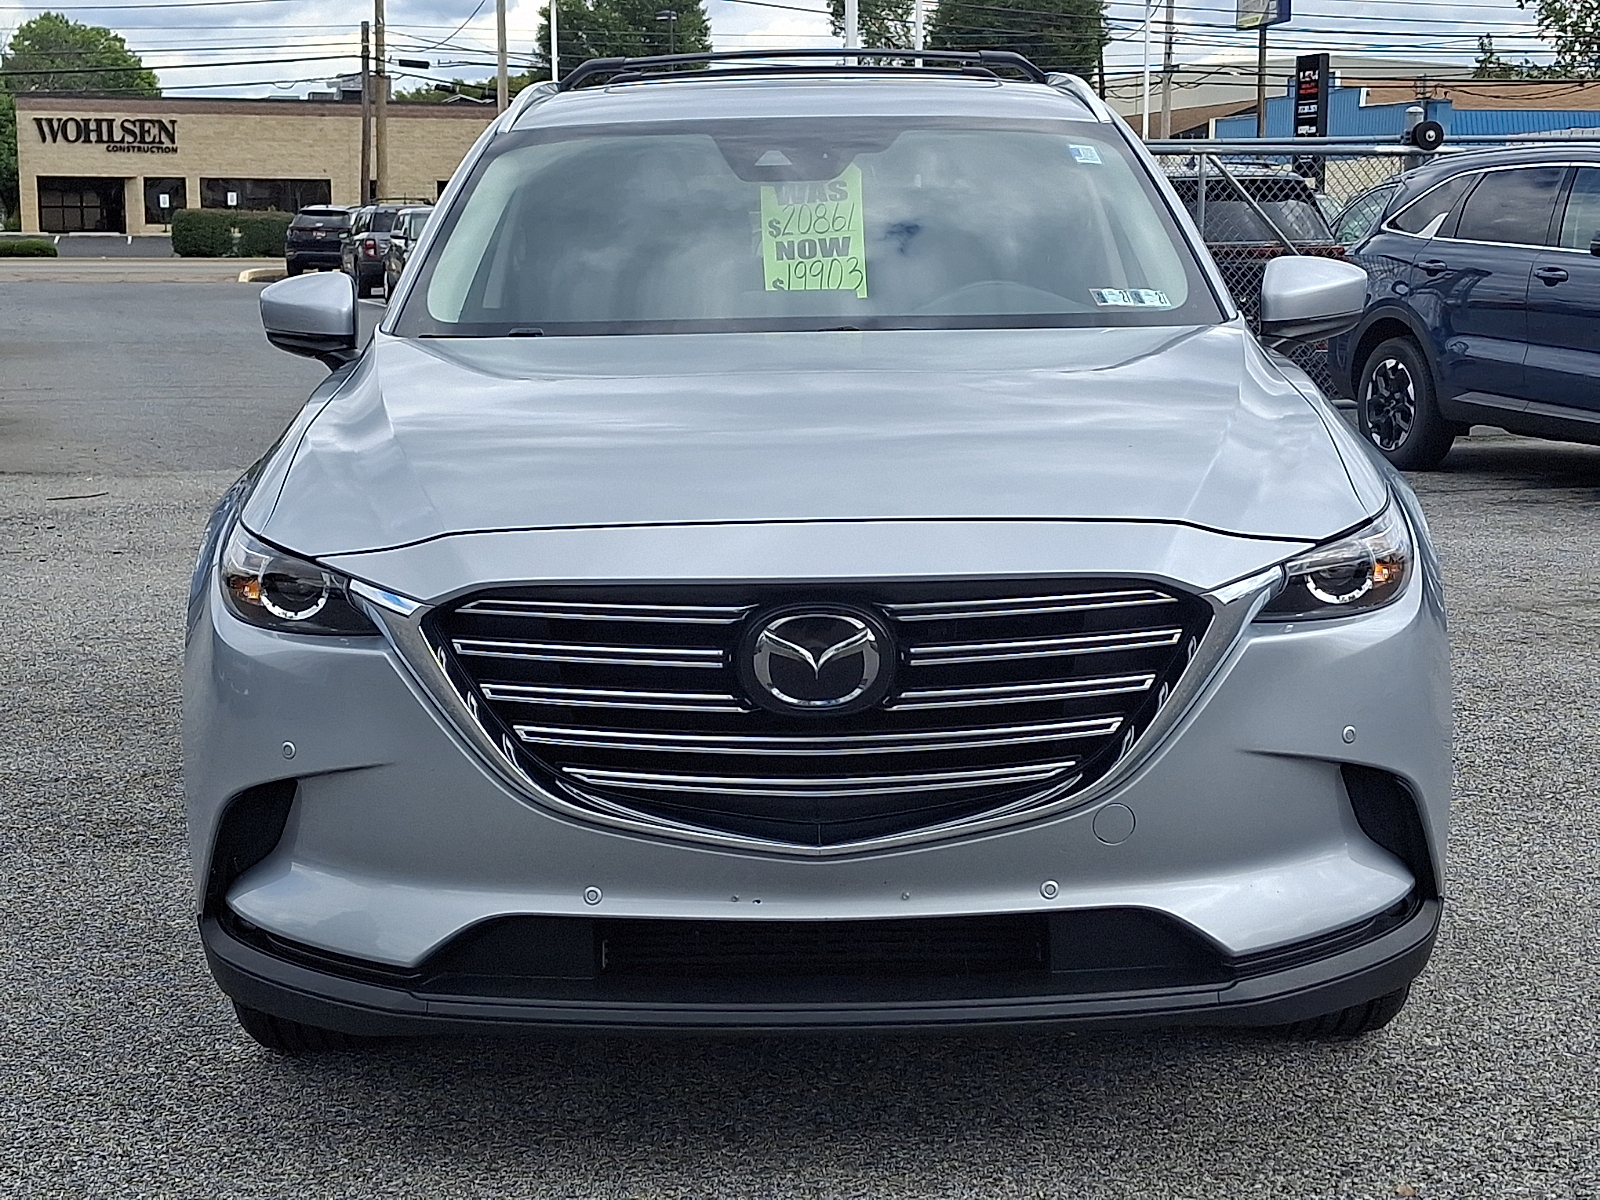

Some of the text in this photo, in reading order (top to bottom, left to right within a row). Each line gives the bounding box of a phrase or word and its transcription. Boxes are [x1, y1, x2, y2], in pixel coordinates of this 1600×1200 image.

[33, 117, 178, 144] WOHLSEN
[106, 144, 178, 154] CONSTRUCTION
[775, 180, 848, 205] WAS
[775, 236, 851, 261] NOW
